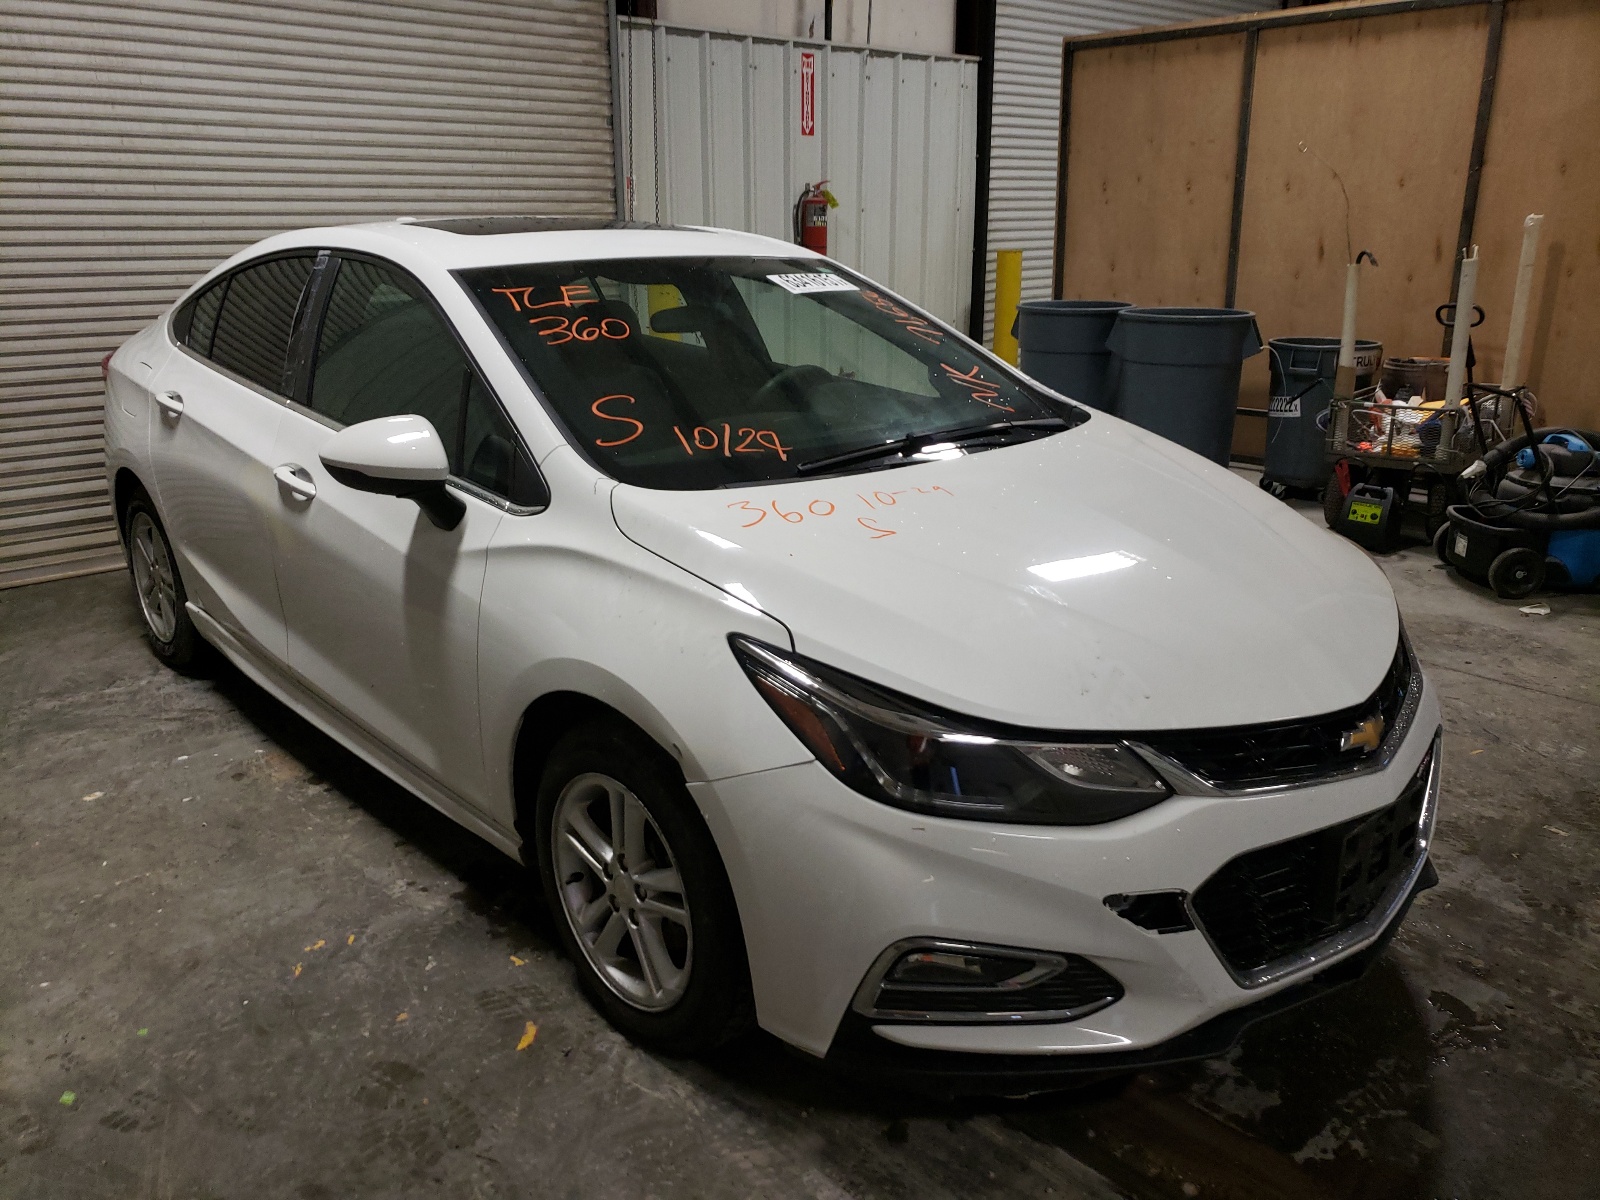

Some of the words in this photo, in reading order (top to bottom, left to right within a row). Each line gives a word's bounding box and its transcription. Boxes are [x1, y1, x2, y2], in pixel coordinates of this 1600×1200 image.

[529, 316, 630, 346] 360
[591, 394, 645, 447] S
[727, 499, 835, 528] 360
